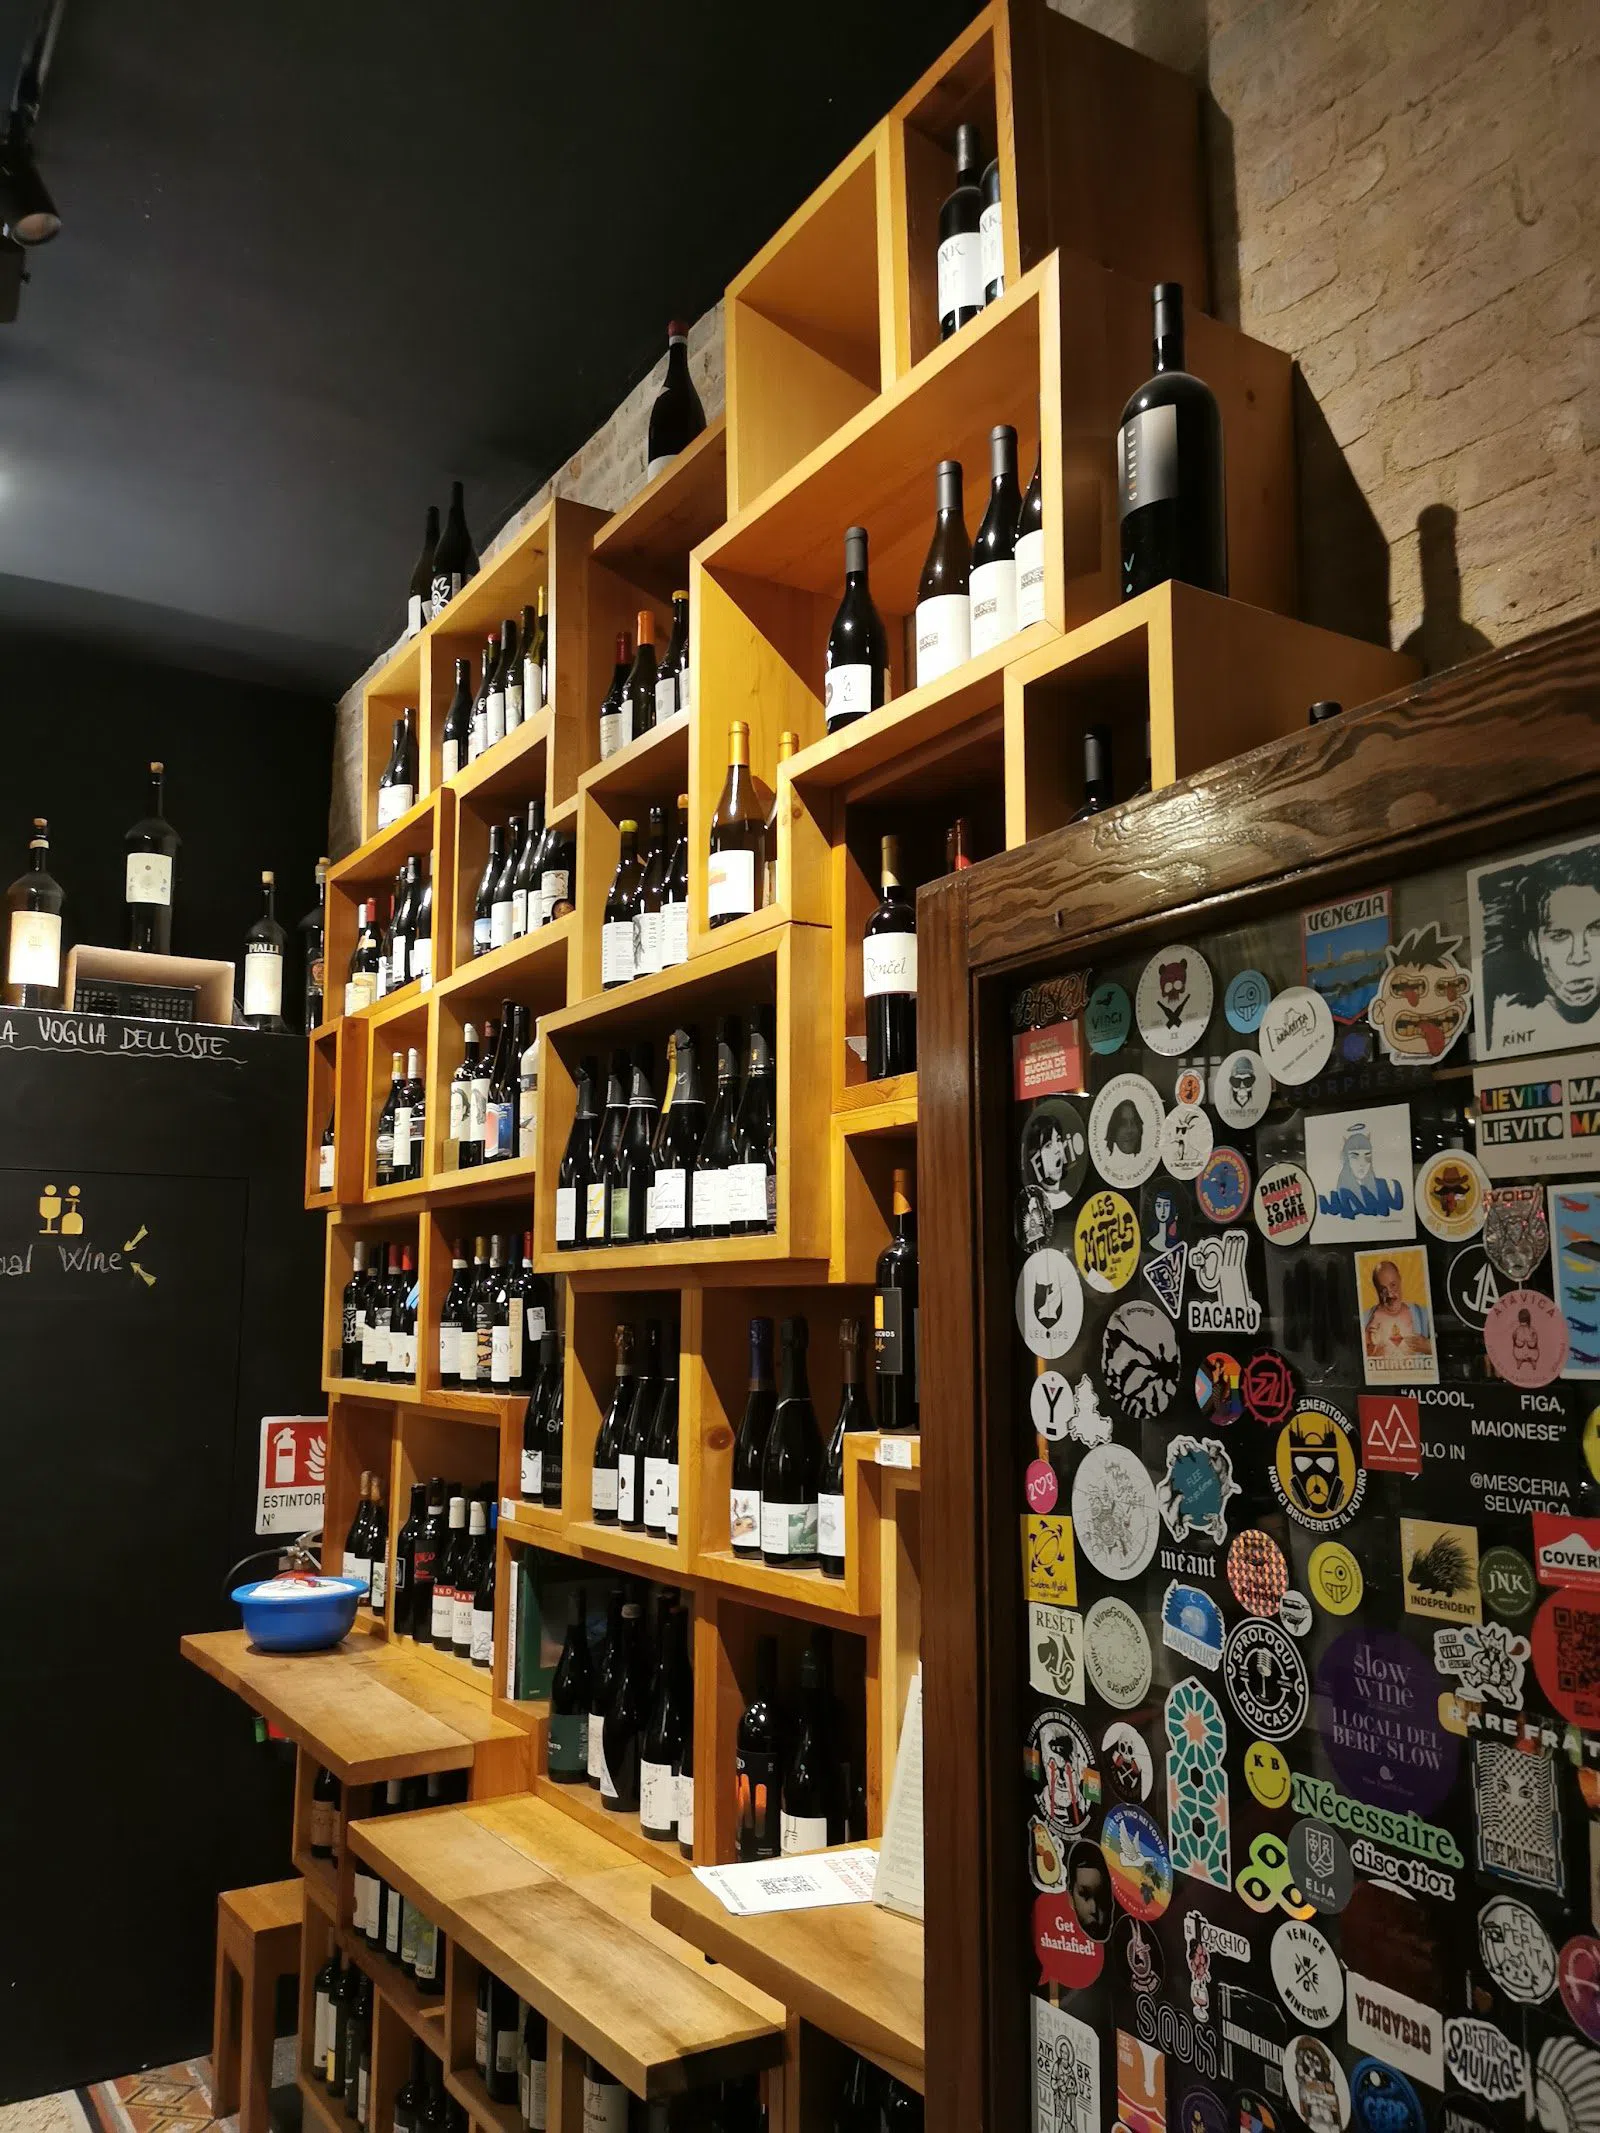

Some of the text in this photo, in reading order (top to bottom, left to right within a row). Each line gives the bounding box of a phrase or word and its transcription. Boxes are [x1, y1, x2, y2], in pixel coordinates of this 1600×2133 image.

[1127, 426, 1137, 502] GRAVNER
[1307, 895, 1385, 931] VENEZIA
[0, 1020, 18, 1043] A
[38, 1016, 108, 1045] VOGLIA
[1480, 1081, 1562, 1113] LIEVITO
[1482, 1115, 1563, 1143] LIEVITO
[1260, 1173, 1299, 1196] DRINK
[1089, 1194, 1114, 1219] LES
[1265, 1194, 1303, 1215] TO GET
[1267, 1205, 1306, 1227] SOME
[58, 1242, 123, 1273] Wine
[1191, 1306, 1257, 1331] BACARO
[1492, 1293, 1553, 1319] ATAVICA
[1520, 1394, 1566, 1416] FIGA,
[1450, 1444, 1466, 1460] IN
[1470, 1472, 1571, 1498] @MESCERIA
[263, 1492, 325, 1508] ESTINTOR
[1267, 1465, 1280, 1491] NON
[1287, 1503, 1341, 1532] BRUCERETE
[1349, 1468, 1368, 1517] FUTURO
[1484, 1494, 1572, 1517] SELVATICA
[1542, 1549, 1600, 1568] COVER
[1487, 1569, 1528, 1594] JNK
[1409, 1595, 1475, 1616] INDEPENDENT
[1035, 1609, 1075, 1635] RESET
[1231, 1626, 1294, 1669] SPROLOQUI
[1236, 1690, 1293, 1727] PODCAST
[1446, 1704, 1516, 1735] RARE
[1341, 1709, 1402, 1742] LOCALI
[1406, 1727, 1443, 1751] DEL
[1332, 1727, 1444, 1770] BERE SLOW
[1296, 1777, 1462, 1863] Nécessaire.
[1147, 1820, 1166, 1853] VOSTRI
[1305, 1877, 1336, 1900] ELIA
[1055, 1915, 1075, 1933] Get
[1285, 1928, 1326, 1956] VENICE
[1448, 2024, 1522, 2099] SAUVAGE
